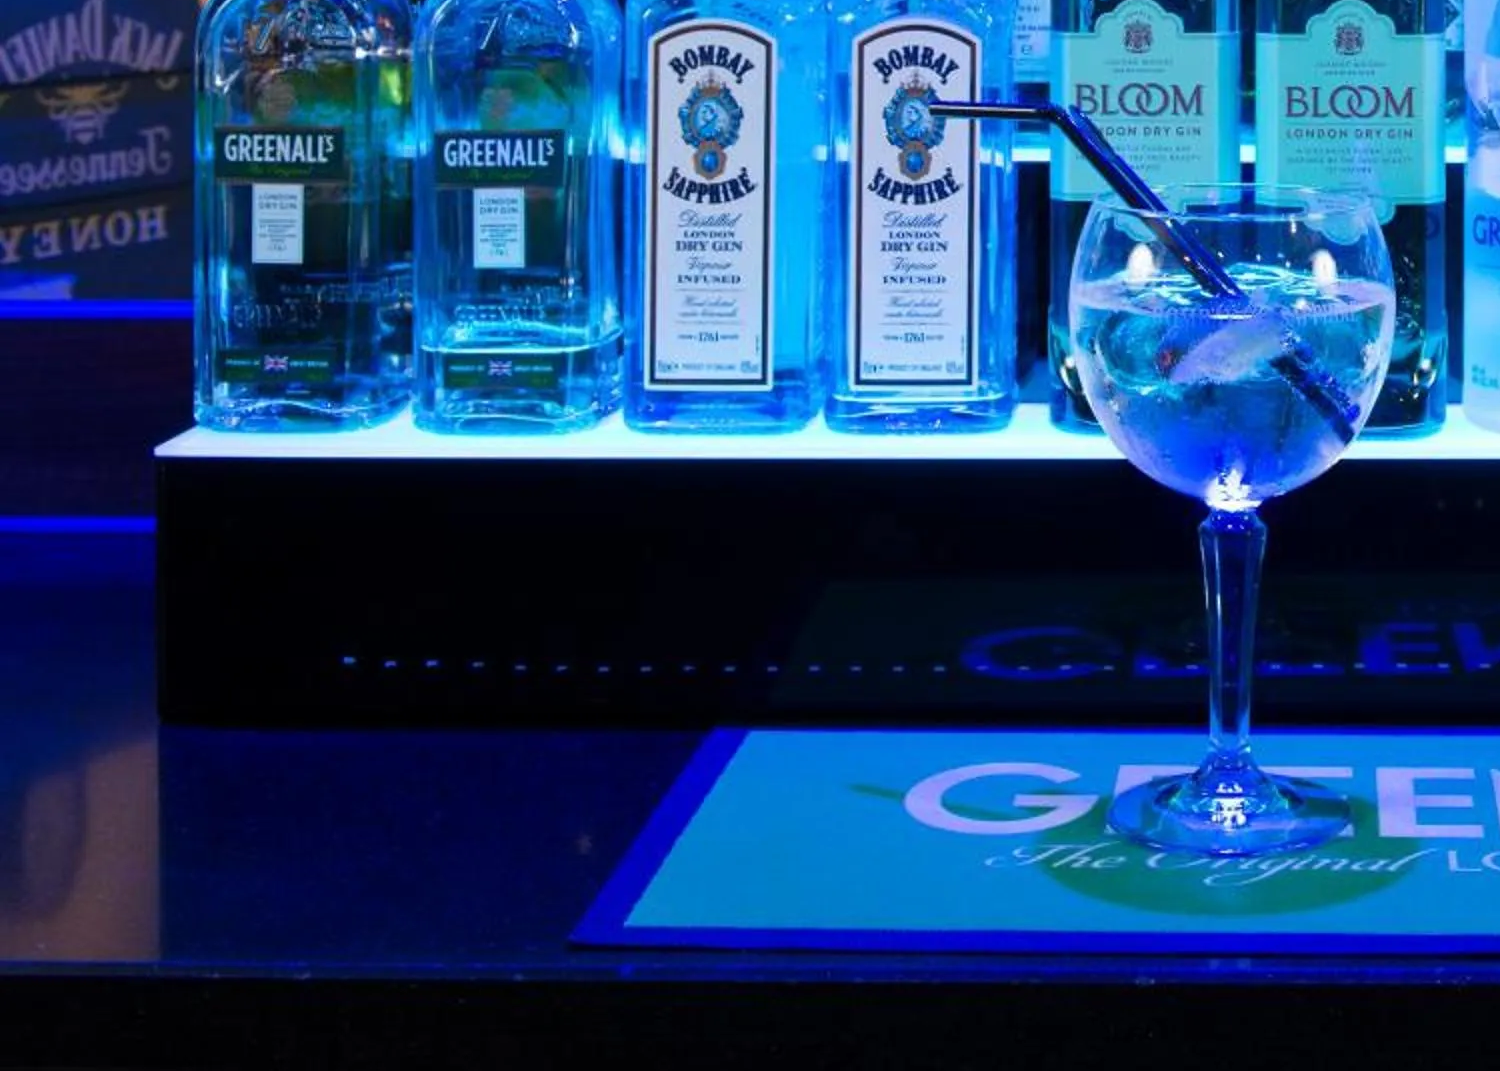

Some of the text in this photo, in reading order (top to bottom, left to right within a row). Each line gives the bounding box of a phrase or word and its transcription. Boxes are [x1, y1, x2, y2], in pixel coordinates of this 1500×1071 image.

[668, 44, 755, 85] BOMBAY
[873, 44, 961, 85] BOMBAY
[1074, 81, 1207, 118] BLOOM
[1284, 84, 1418, 119] BLOOM
[1143, 125, 1171, 137] DRY
[1175, 125, 1202, 137] GIN
[1285, 128, 1414, 140] LONDON DRY GIN
[223, 132, 335, 164] GREENALL'S
[443, 137, 555, 168] GREENALL'S
[662, 166, 757, 206] SAPPHIRE
[867, 166, 962, 206] SAPPHIRE
[683, 230, 736, 239] LONDON
[888, 231, 941, 240] LONDON
[675, 240, 744, 252] DRY GIN
[880, 241, 948, 253] DRY GIN
[677, 274, 742, 285] INFUSED
[882, 275, 947, 286] INFUSED
